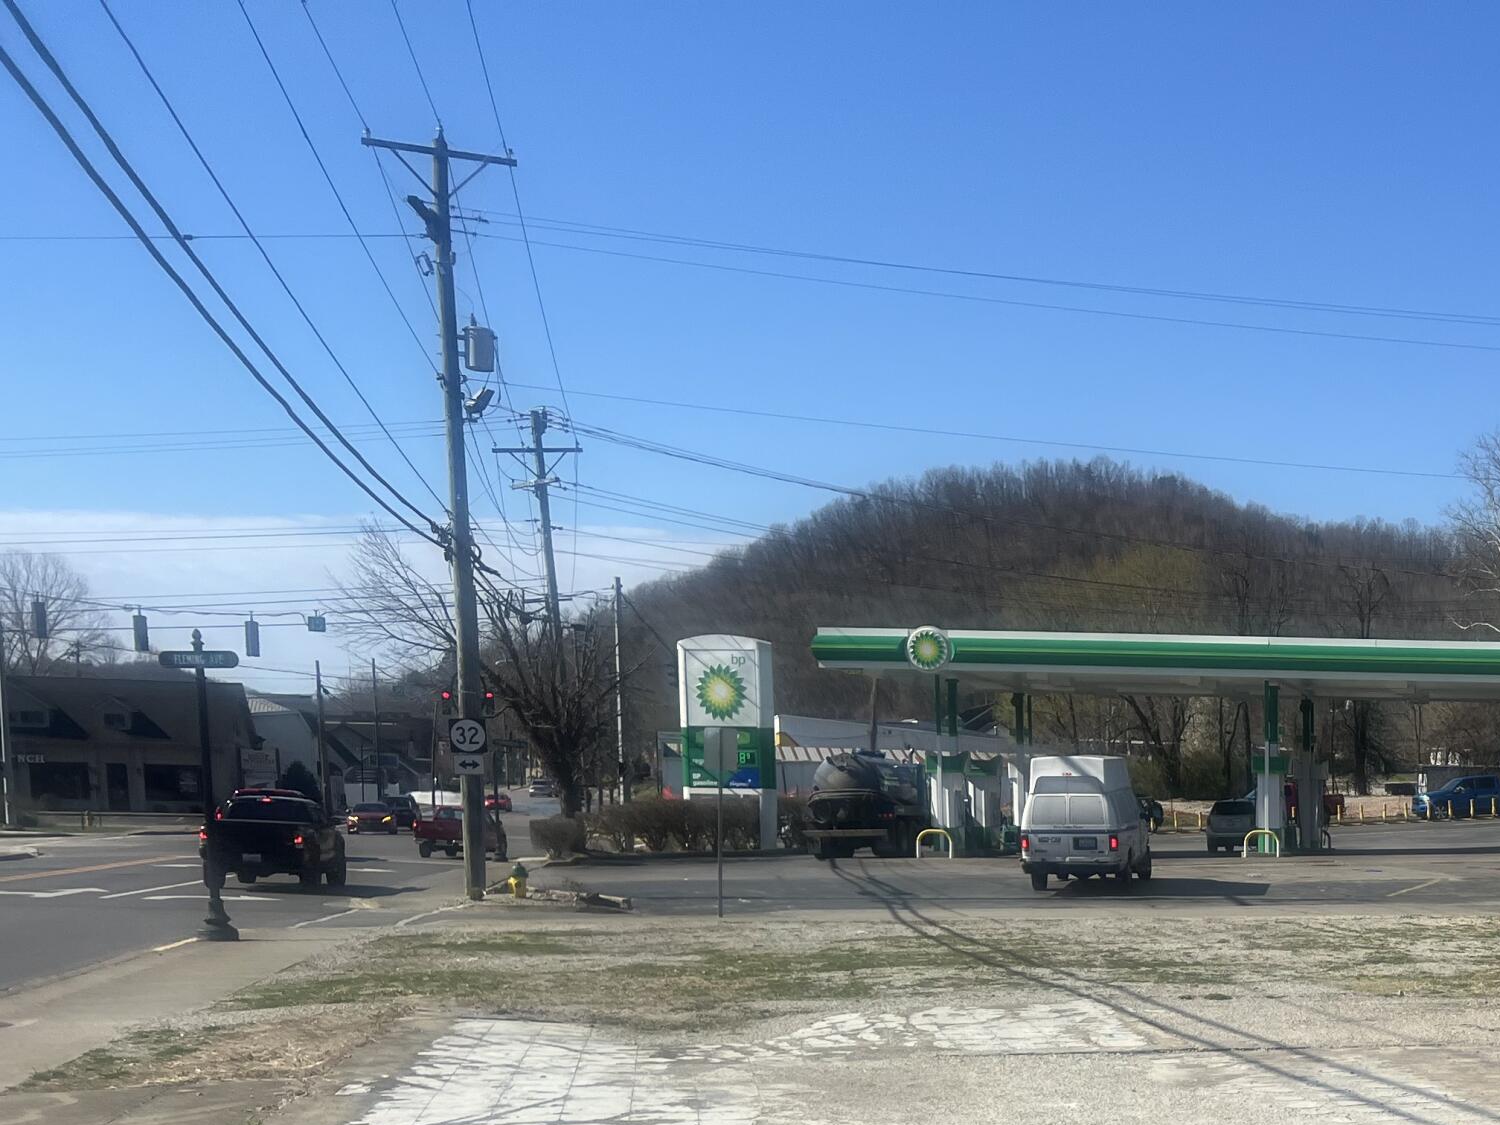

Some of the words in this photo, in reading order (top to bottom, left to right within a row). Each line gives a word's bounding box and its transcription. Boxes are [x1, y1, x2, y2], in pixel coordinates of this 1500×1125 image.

[174, 653, 205, 665] FLEMING
[210, 653, 225, 665] AVE
[731, 653, 746, 667] bp
[456, 726, 480, 745] 32
